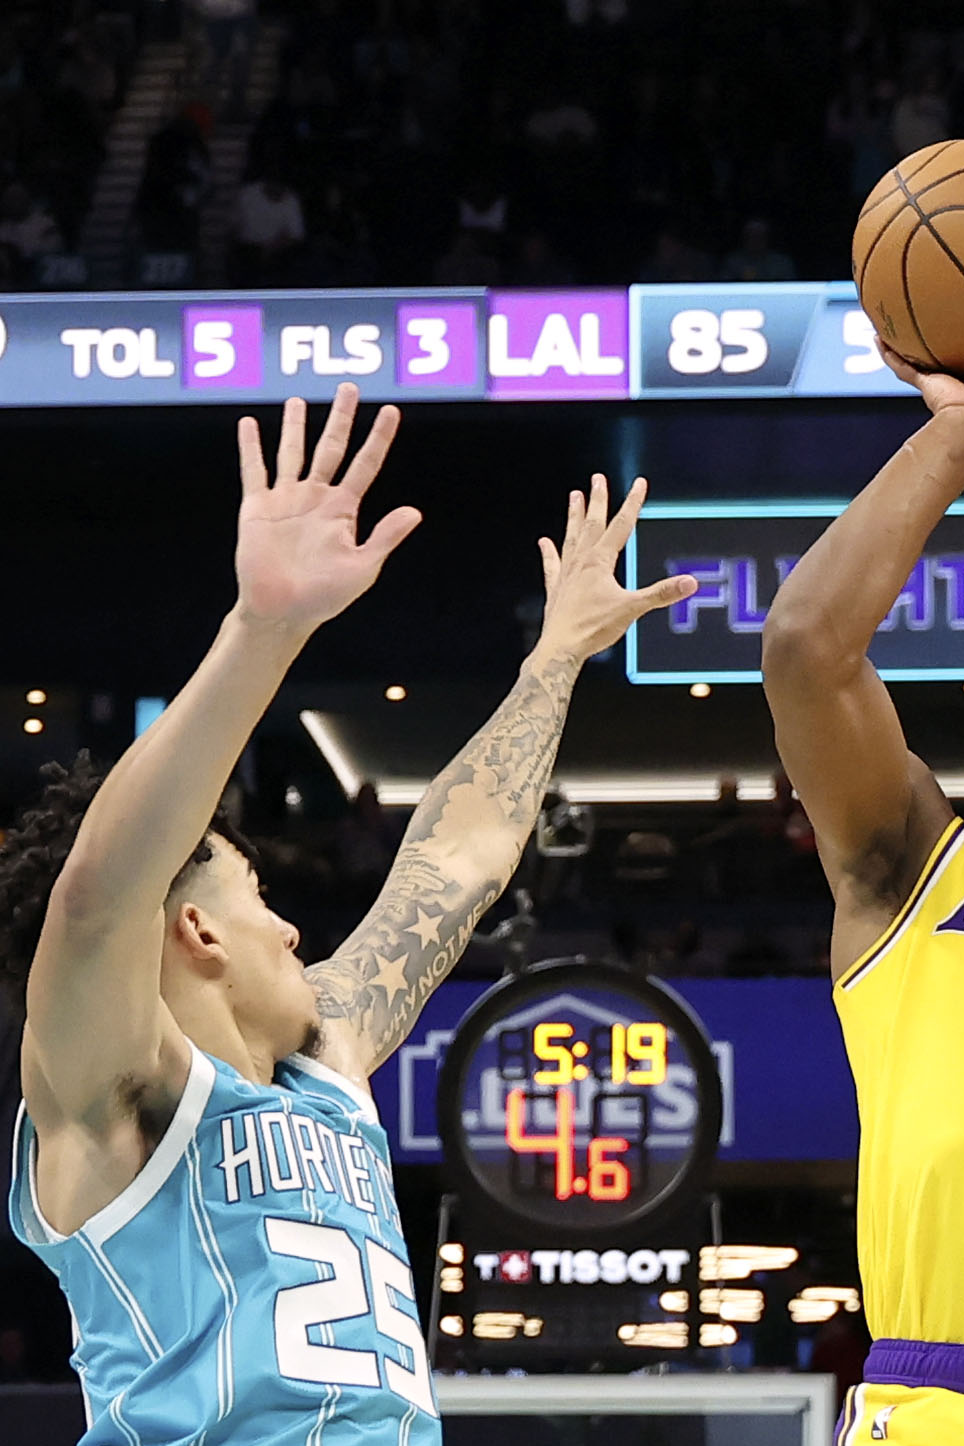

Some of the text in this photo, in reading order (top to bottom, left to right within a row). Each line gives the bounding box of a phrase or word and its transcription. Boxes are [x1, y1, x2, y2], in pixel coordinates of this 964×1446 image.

[60, 318, 450, 379] TOL 5 FLS 3
[488, 313, 626, 378] LAL
[667, 309, 769, 375] 85
[532, 1021, 668, 1086] 5:19
[505, 1087, 632, 1202] 4.6
[531, 1249, 691, 1285] TISSOT
[263, 1215, 439, 1420] 25
